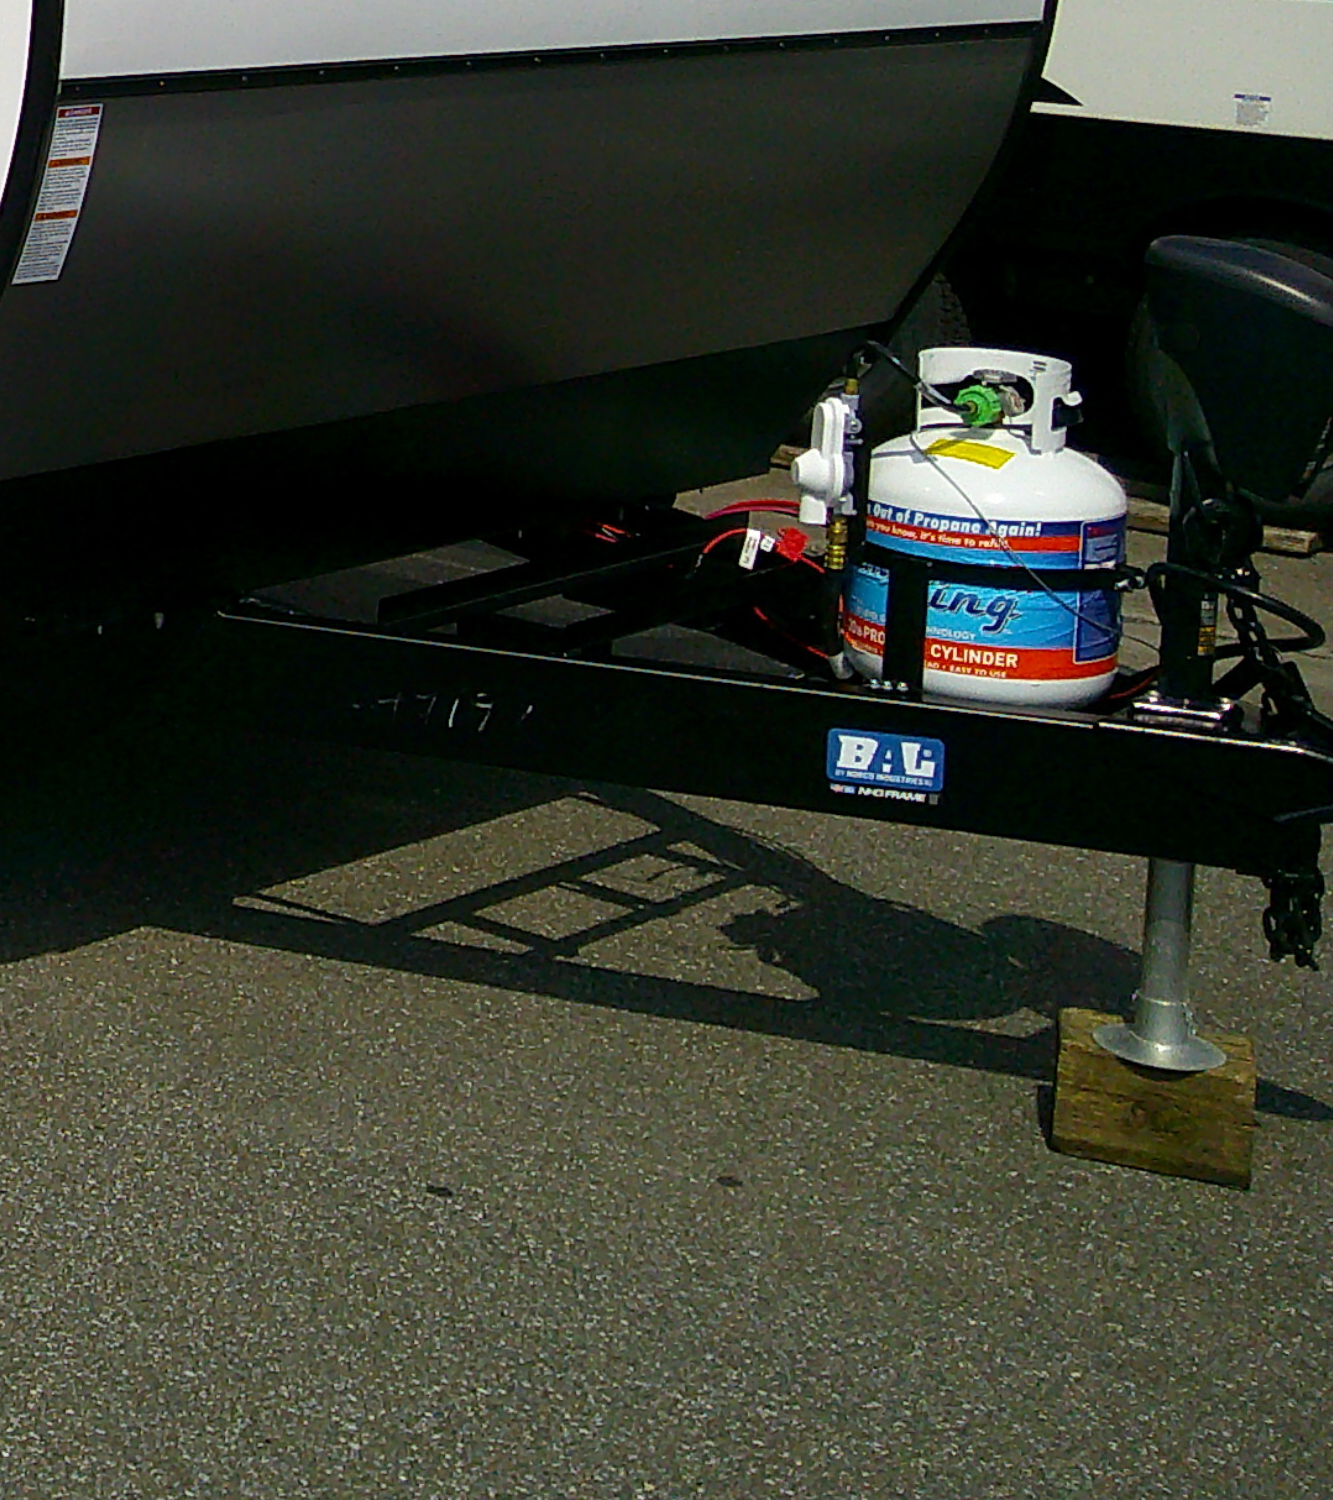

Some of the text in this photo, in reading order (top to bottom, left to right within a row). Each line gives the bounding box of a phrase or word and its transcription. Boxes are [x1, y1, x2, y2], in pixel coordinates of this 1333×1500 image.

[873, 503, 893, 520] Out
[896, 509, 911, 523] of
[914, 513, 981, 534] Propane
[986, 521, 1042, 538] Again!
[928, 584, 1021, 635] ing
[863, 625, 886, 646] PRO
[930, 644, 1019, 669] CYLINDER
[949, 664, 972, 676] EASY
[973, 667, 987, 676] TO
[989, 669, 1007, 679] USE
[836, 734, 936, 778] BAL
